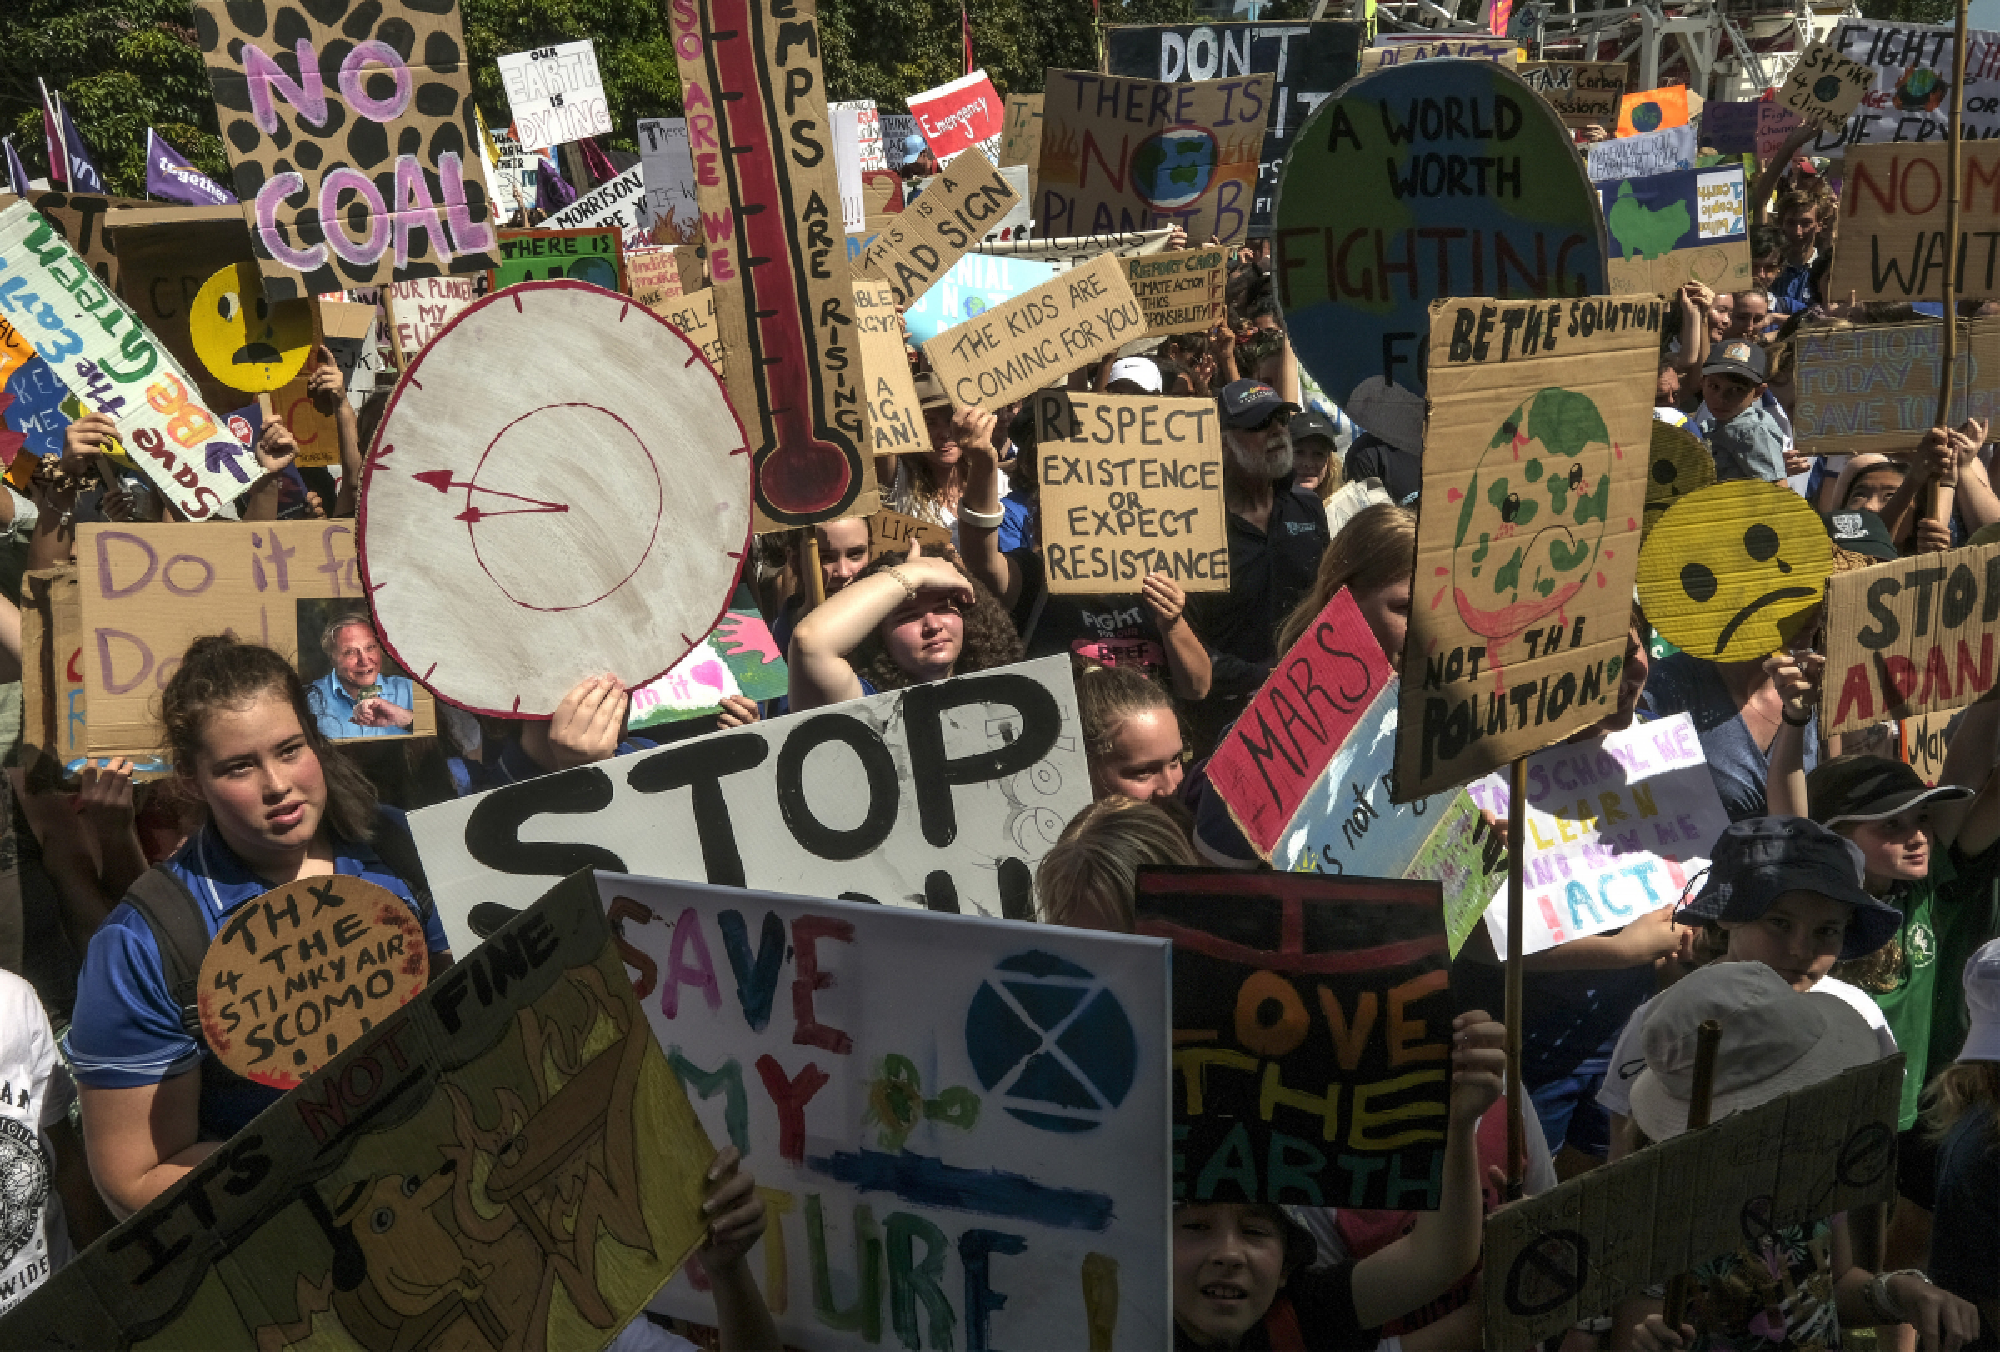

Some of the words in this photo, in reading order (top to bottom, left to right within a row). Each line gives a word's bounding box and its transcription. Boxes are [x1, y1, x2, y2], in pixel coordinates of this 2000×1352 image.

[501, 51, 601, 106] EARTH
[531, 47, 558, 60] OUR
[1160, 26, 1311, 83] DON'T
[1837, 24, 1955, 68] FIGHT
[240, 38, 413, 134] NO
[550, 92, 564, 107] IS
[1062, 73, 1198, 127] THERE
[1212, 79, 1264, 128] IS
[1522, 66, 1574, 92] TAX
[1575, 71, 1624, 88] Carbon
[516, 97, 610, 149] DYING
[685, 81, 721, 187] ARE
[1327, 104, 1363, 153] A
[1379, 94, 1524, 146] WORLD
[159, 156, 229, 204] together
[1386, 151, 1522, 198] WORTH
[1847, 155, 1943, 217] NO
[256, 150, 494, 271] COAL
[864, 227, 904, 271] THIS
[943, 177, 958, 194] A
[936, 171, 1013, 249] SIGN
[1214, 180, 1244, 246] B
[500, 237, 580, 260] THERE
[591, 234, 612, 253] IS
[702, 207, 737, 281] WE
[1276, 226, 1588, 308] FIGHTING
[417, 303, 447, 323] MY
[802, 190, 835, 279] ARE
[820, 297, 864, 443] RISING
[951, 322, 1001, 364] THE
[1004, 294, 1060, 338] KIDS
[1068, 272, 1109, 309] ARE
[1448, 304, 1497, 362] BE
[1500, 302, 1562, 362] THE
[1566, 297, 1664, 337] SOLUTION
[1799, 327, 1940, 363] ACTION
[955, 339, 1060, 407] COMING
[1059, 320, 1104, 359] FOR
[1098, 298, 1141, 342] YOU
[1800, 362, 1913, 395] TODAY
[75, 356, 127, 419] the
[145, 372, 219, 450] Be
[1795, 398, 1886, 441] SAVE
[1040, 396, 1216, 446] RESPECT
[131, 427, 223, 520] Save
[1042, 454, 1221, 491] EXISTENCE
[1107, 491, 1144, 512] OR
[1067, 505, 1199, 538] EXPECT
[94, 529, 215, 600] Do
[251, 526, 297, 594] it
[1047, 542, 1229, 582] RESISTANCE
[1423, 645, 1487, 691] NOT
[1524, 616, 1587, 659] THE
[1237, 621, 1371, 818] MARS
[465, 674, 1062, 888] STOP
[1527, 744, 1650, 802] SCHOOL
[1652, 722, 1697, 763] WE
[1527, 782, 1660, 851] LEARN
[1653, 812, 1701, 847] WE
[221, 879, 345, 956] THX
[259, 912, 372, 975] THE
[214, 969, 244, 995] 4
[219, 956, 346, 1034] STINKY
[355, 933, 405, 973] AIR
[607, 894, 857, 1056] SAVE
[244, 968, 395, 1067] SCOMO
[296, 1017, 413, 1144] NOT
[431, 910, 560, 1036] FINE
[1173, 967, 1449, 1070] OVE
[666, 1043, 831, 1169] MY
[1173, 1047, 1447, 1151] THE
